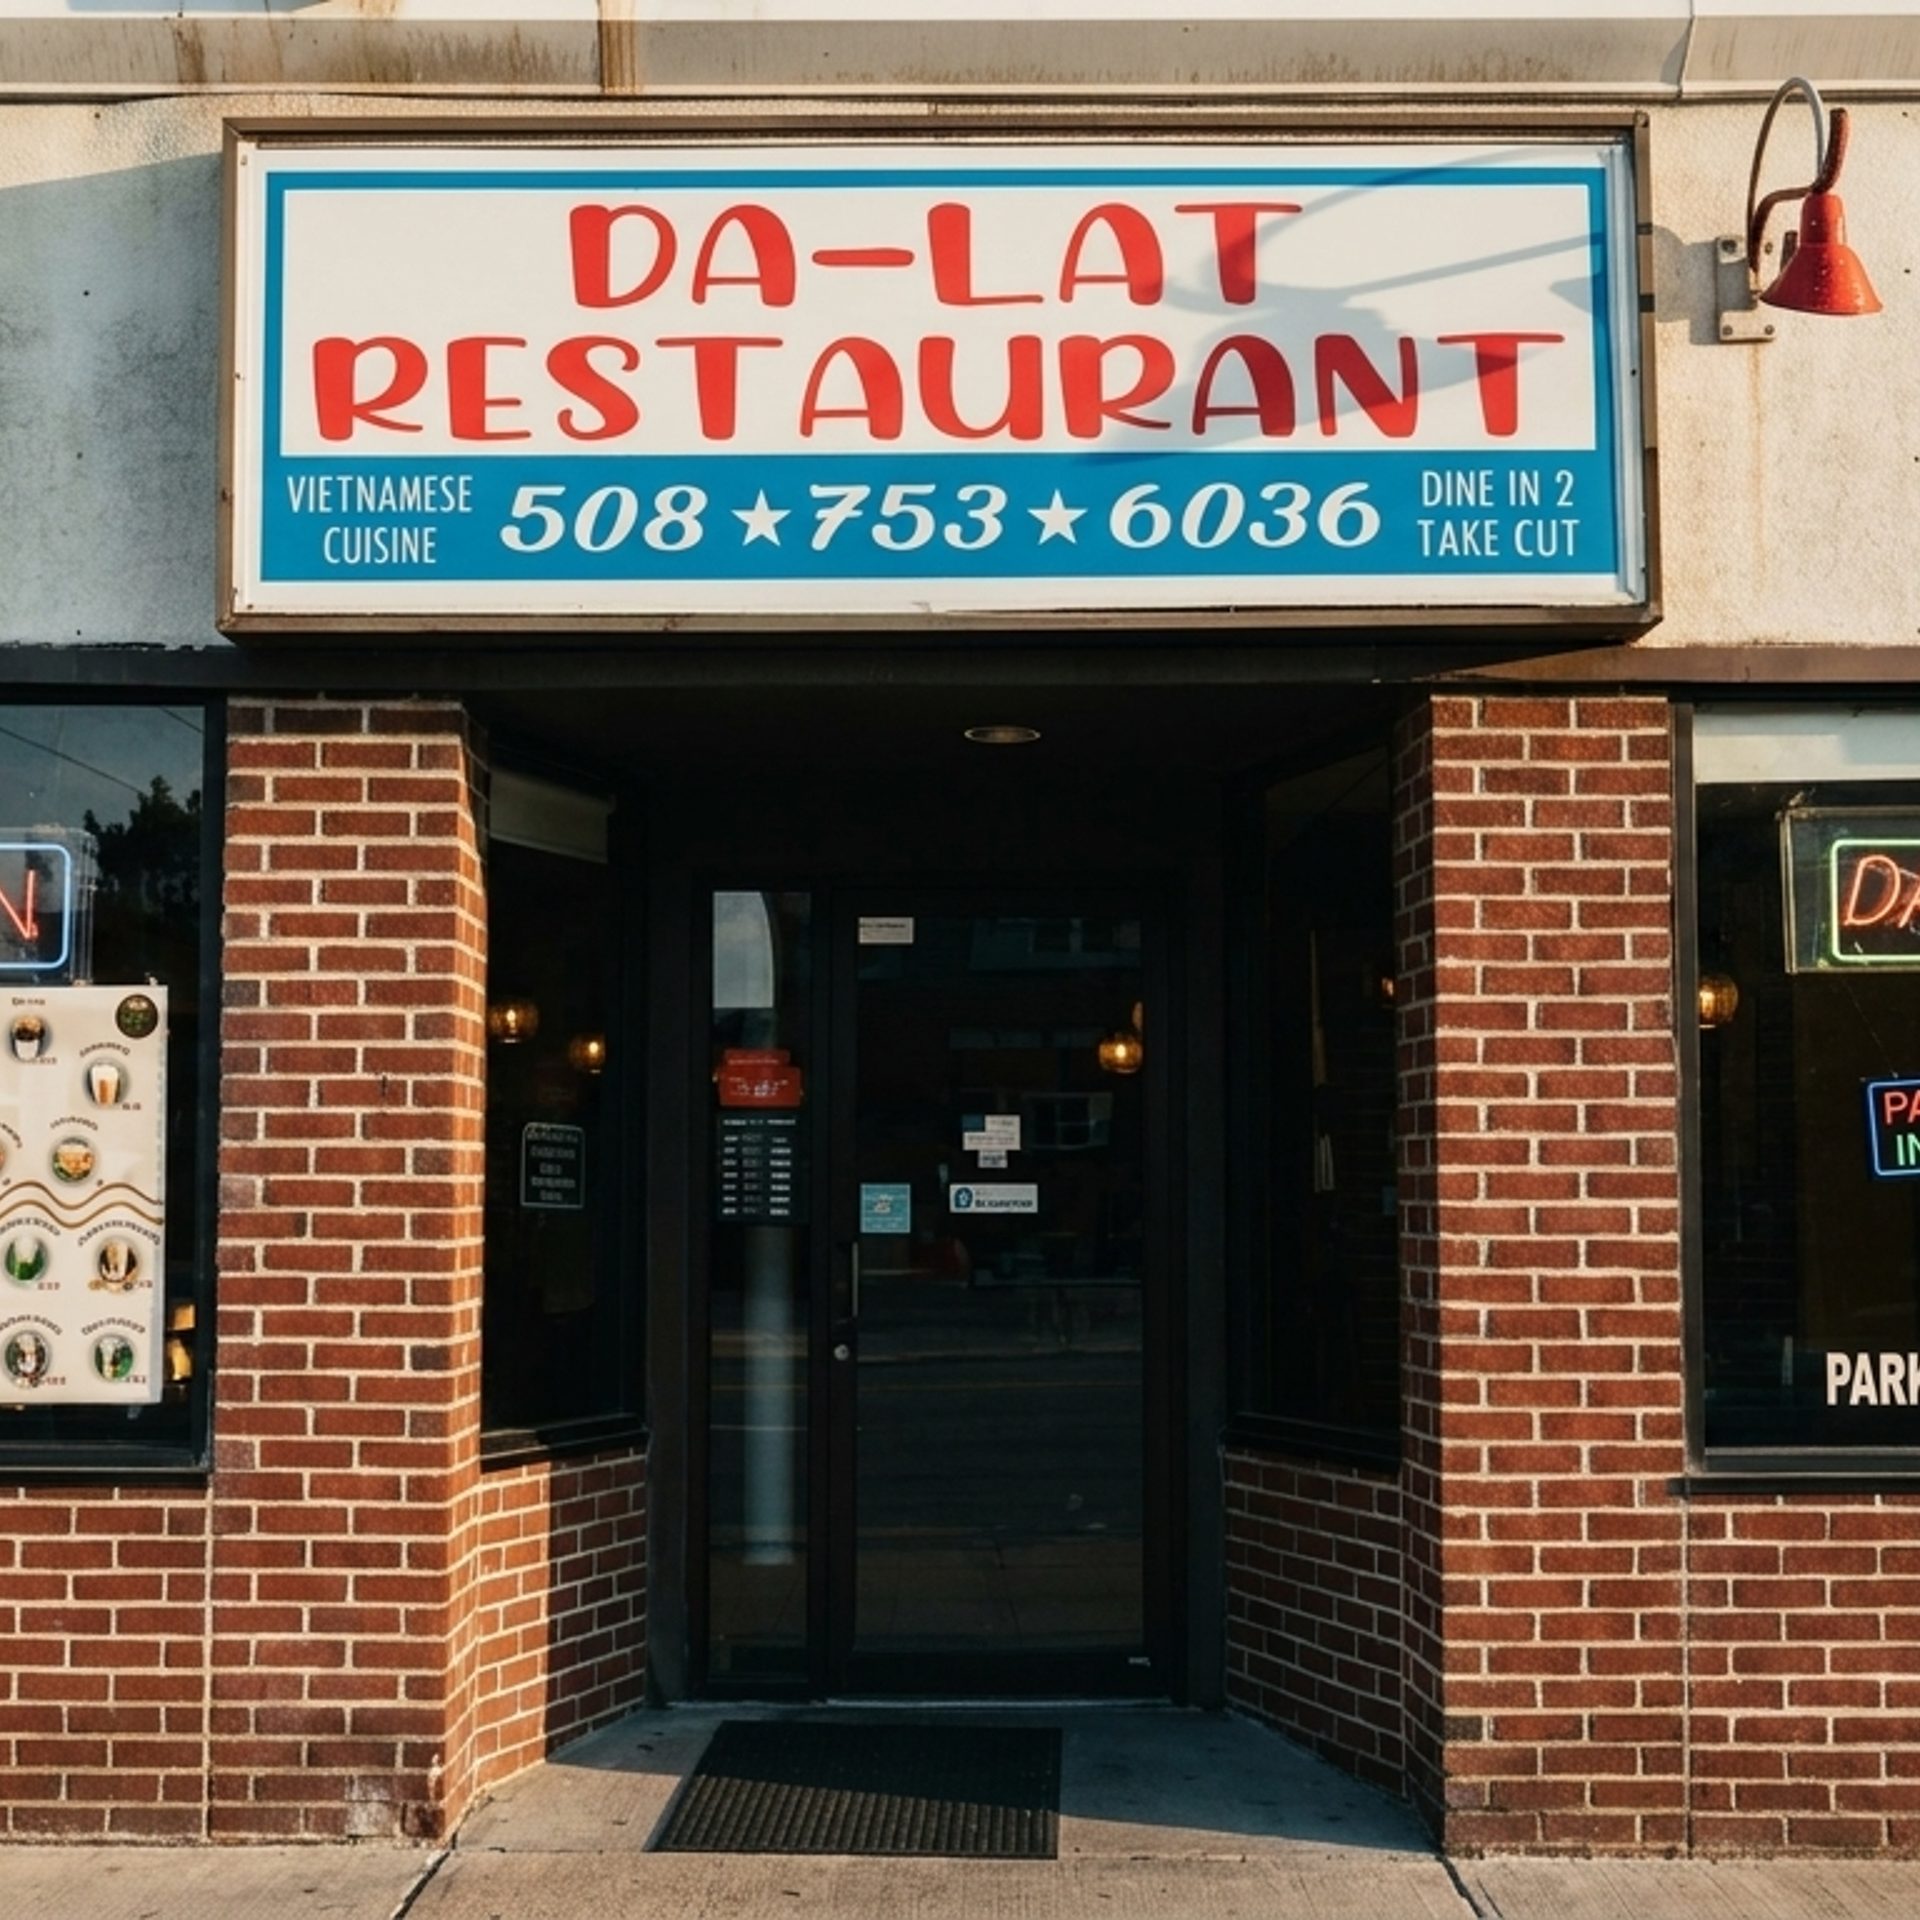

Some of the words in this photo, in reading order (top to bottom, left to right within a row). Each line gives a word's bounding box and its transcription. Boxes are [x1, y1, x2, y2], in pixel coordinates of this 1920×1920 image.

[568, 202, 1302, 310] DA-LAT
[312, 332, 1564, 441] RESTAURANT
[287, 475, 472, 514] VIETNAMESE
[1422, 470, 1495, 507] DINE
[1508, 470, 1540, 507] IN
[1555, 469, 1574, 507] 2
[500, 484, 708, 554] 508
[809, 484, 1008, 552] 753
[1109, 481, 1381, 549] 6036
[324, 526, 437, 565] CUISINE
[1417, 519, 1499, 557] TAKE
[1513, 519, 1580, 557] CUT
